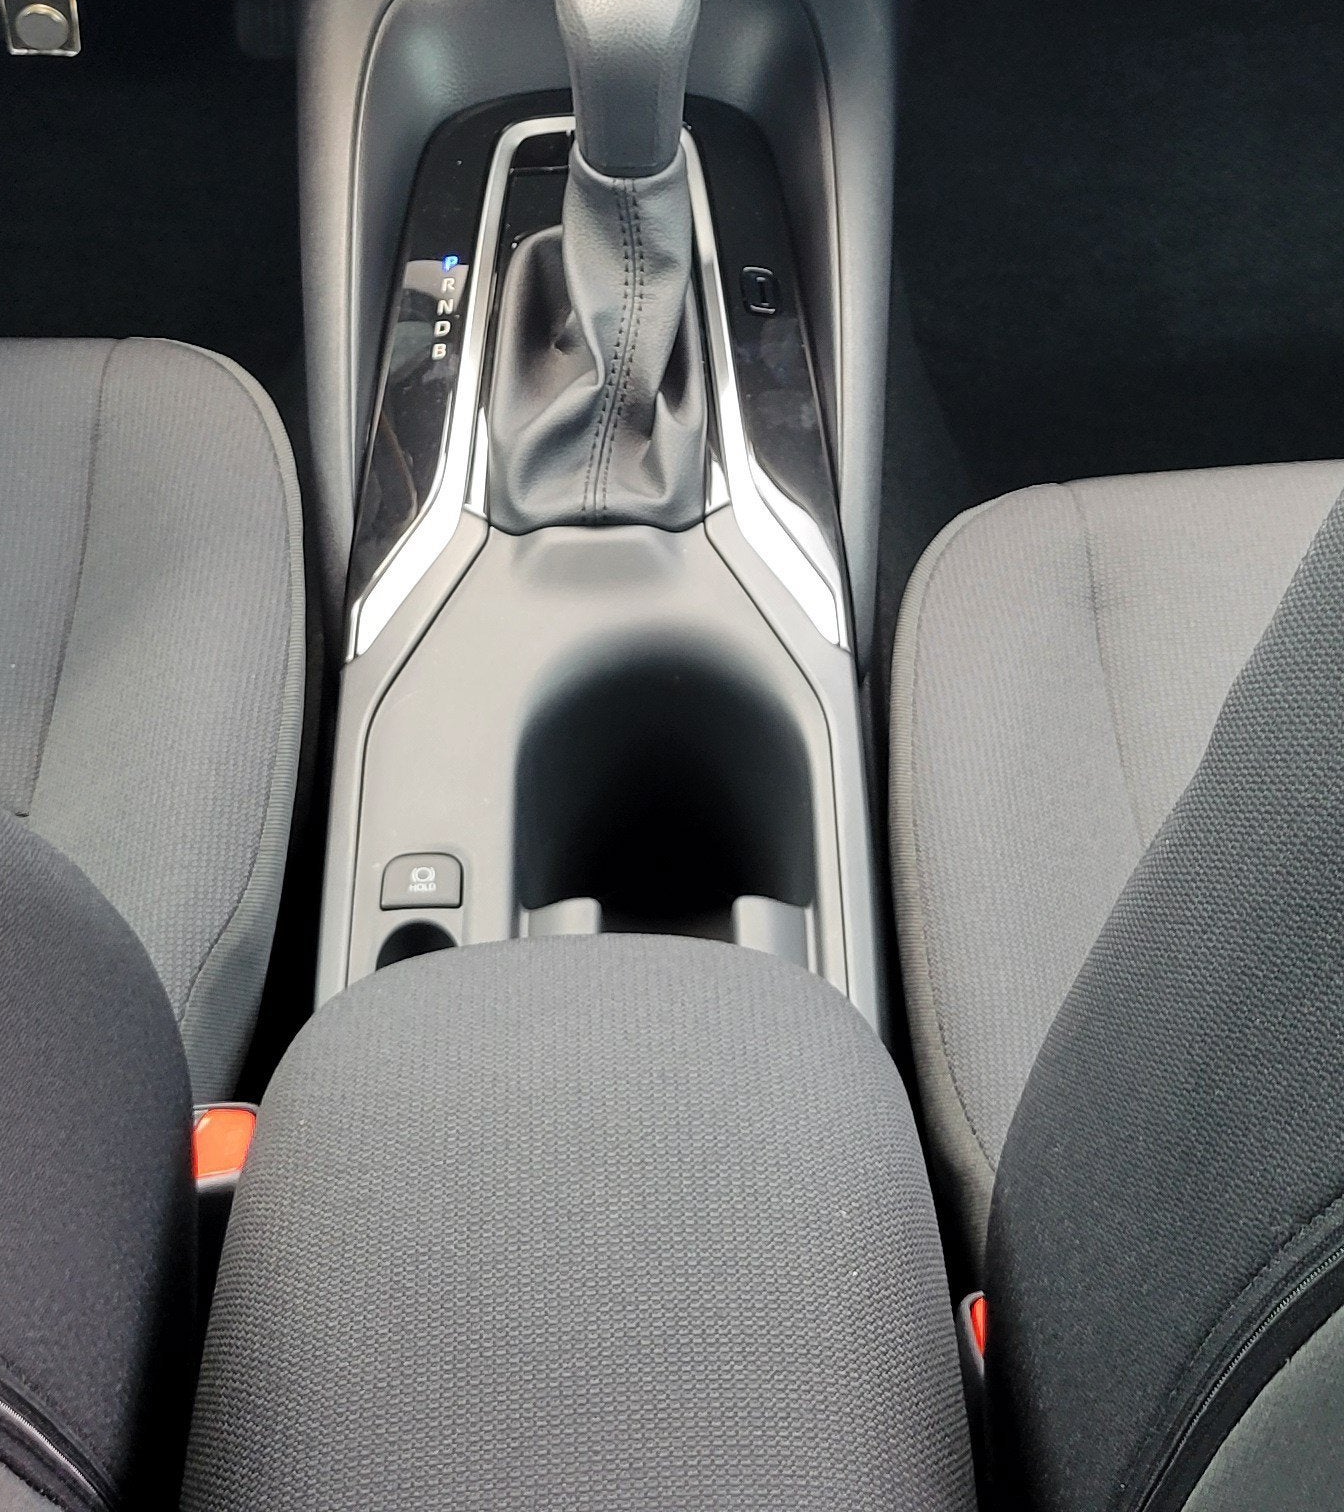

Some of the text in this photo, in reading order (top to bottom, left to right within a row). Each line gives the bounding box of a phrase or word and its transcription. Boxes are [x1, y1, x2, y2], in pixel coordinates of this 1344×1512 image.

[444, 256, 459, 272] P
[442, 277, 456, 292] R
[437, 299, 454, 315] N
[434, 320, 451, 337] D
[431, 343, 448, 360] B
[409, 883, 436, 892] HOLD
